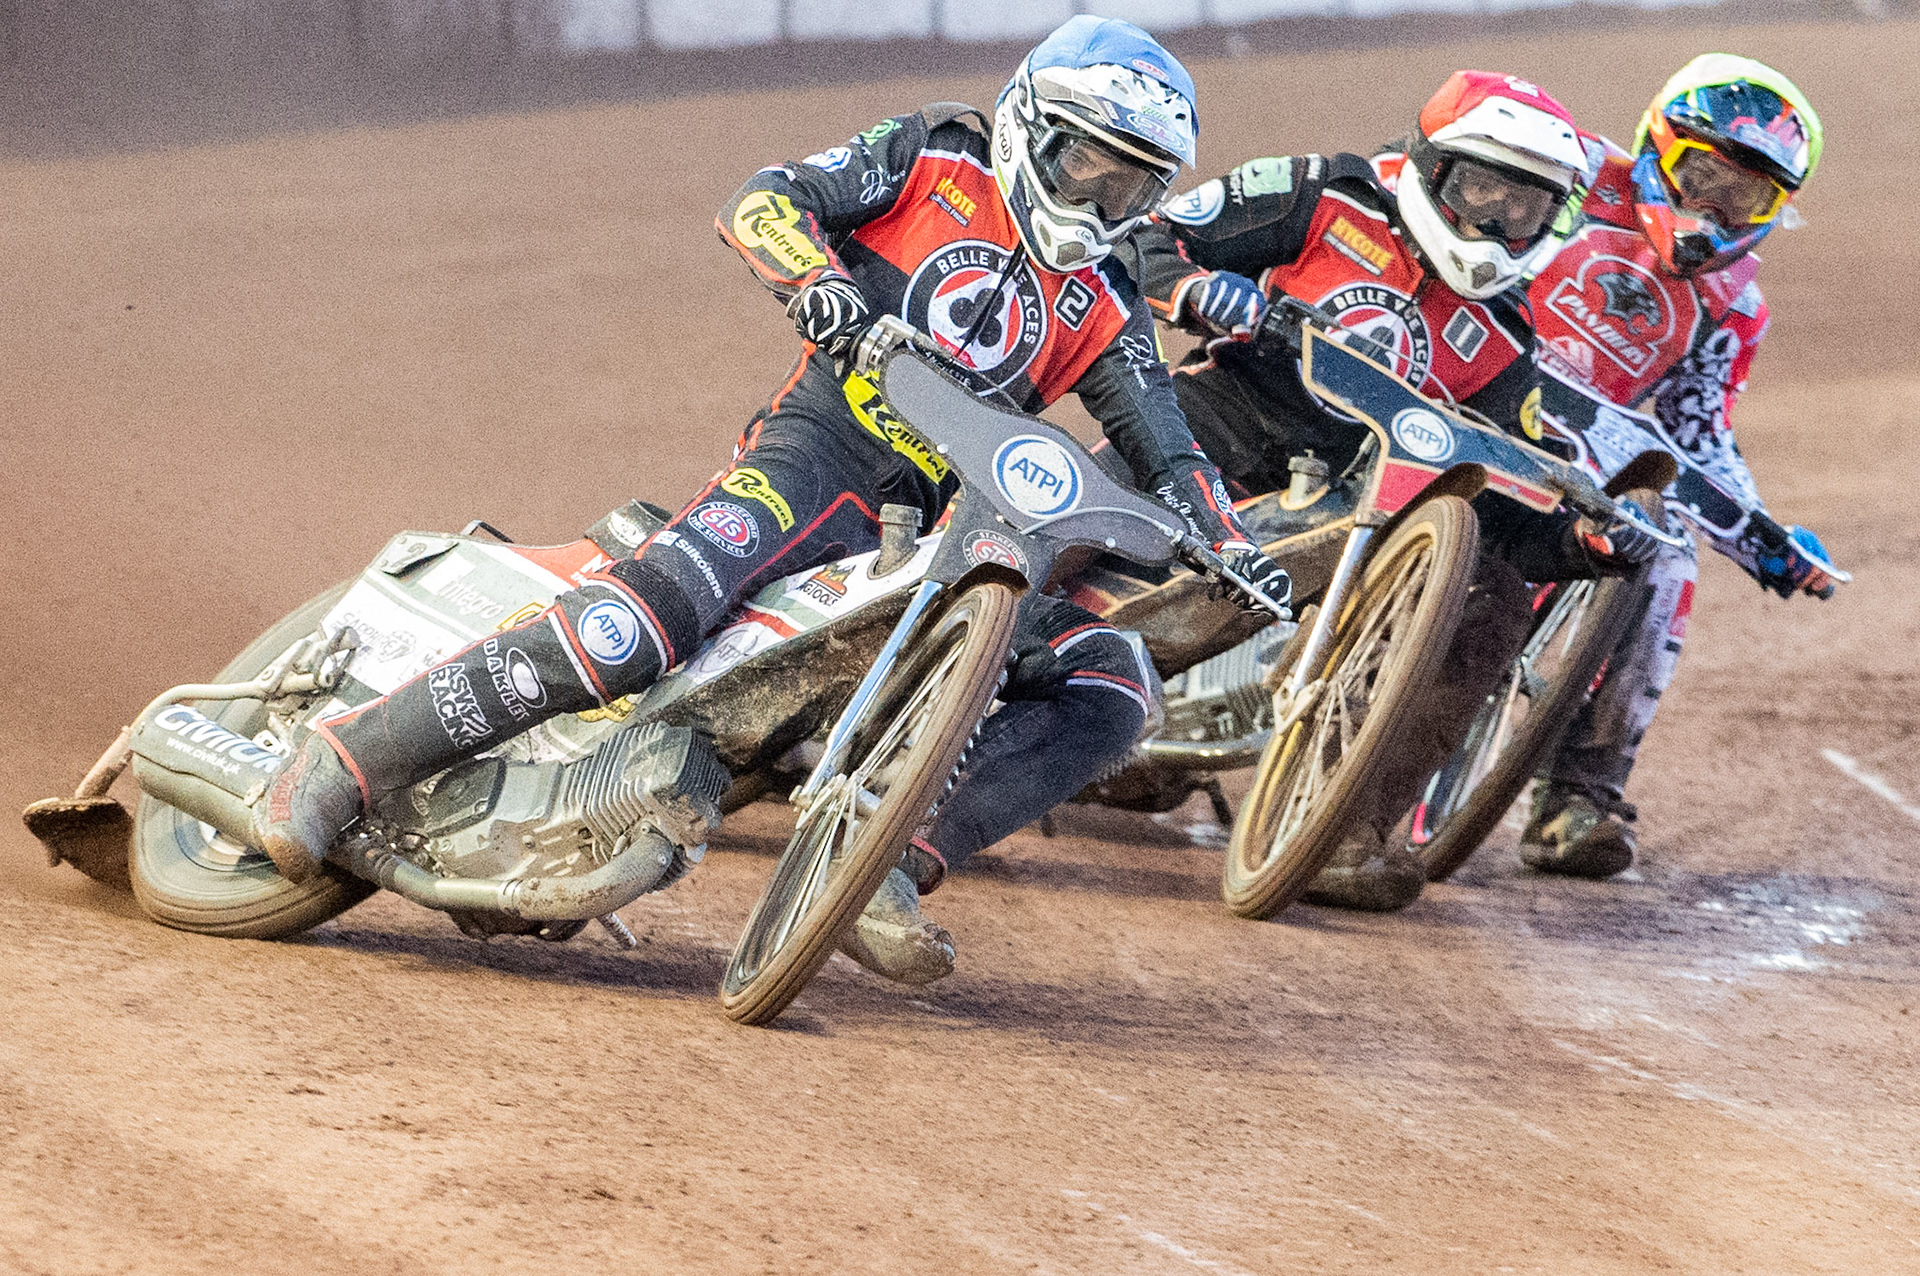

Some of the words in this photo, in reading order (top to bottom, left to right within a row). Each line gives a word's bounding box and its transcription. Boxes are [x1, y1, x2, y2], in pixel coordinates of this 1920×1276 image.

[741, 194, 812, 269] Rentruck
[935, 250, 990, 275] BELLE
[1022, 295, 1037, 346] ACES
[1333, 288, 1388, 310] BELLE
[1402, 423, 1443, 448] ATPI
[729, 472, 790, 527] Rentruck
[1008, 456, 1064, 498] ATPI
[704, 511, 742, 538] STS
[675, 538, 724, 599] Silkolene
[593, 613, 626, 651] ATPI
[430, 666, 476, 748] RACING
